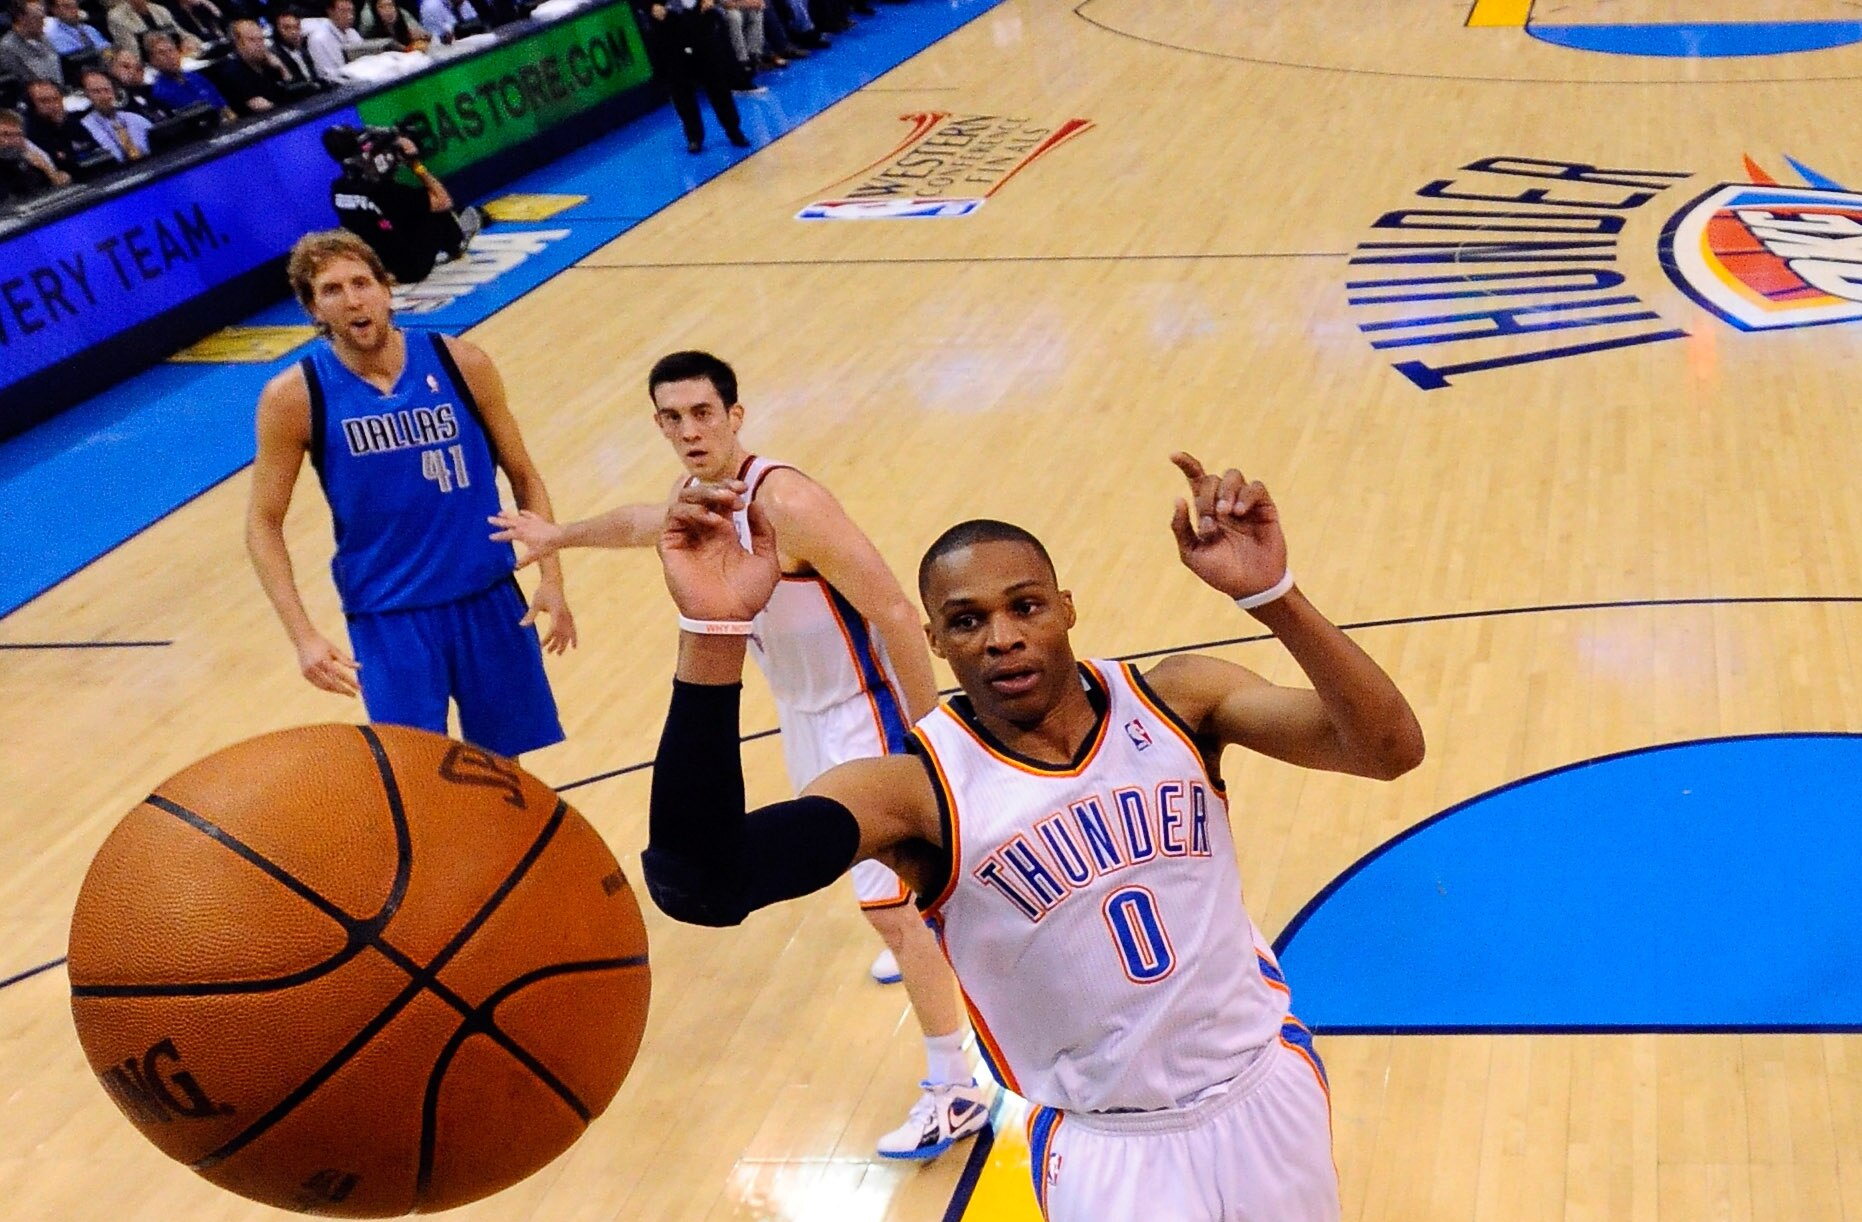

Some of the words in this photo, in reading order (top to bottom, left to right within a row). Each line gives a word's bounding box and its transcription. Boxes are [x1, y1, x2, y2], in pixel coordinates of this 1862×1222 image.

[397, 24, 634, 157] BASTORE.COM
[846, 113, 1001, 199] WESTERN
[915, 116, 1032, 197] CONFERENCE
[965, 127, 1050, 183] FINALS
[95, 203, 231, 292] TEAM.
[1345, 154, 1694, 392] THUNDER
[340, 402, 460, 457] DALLAS
[421, 444, 471, 493] 41
[973, 779, 1212, 923] THUNDER
[1101, 884, 1177, 985] 0
